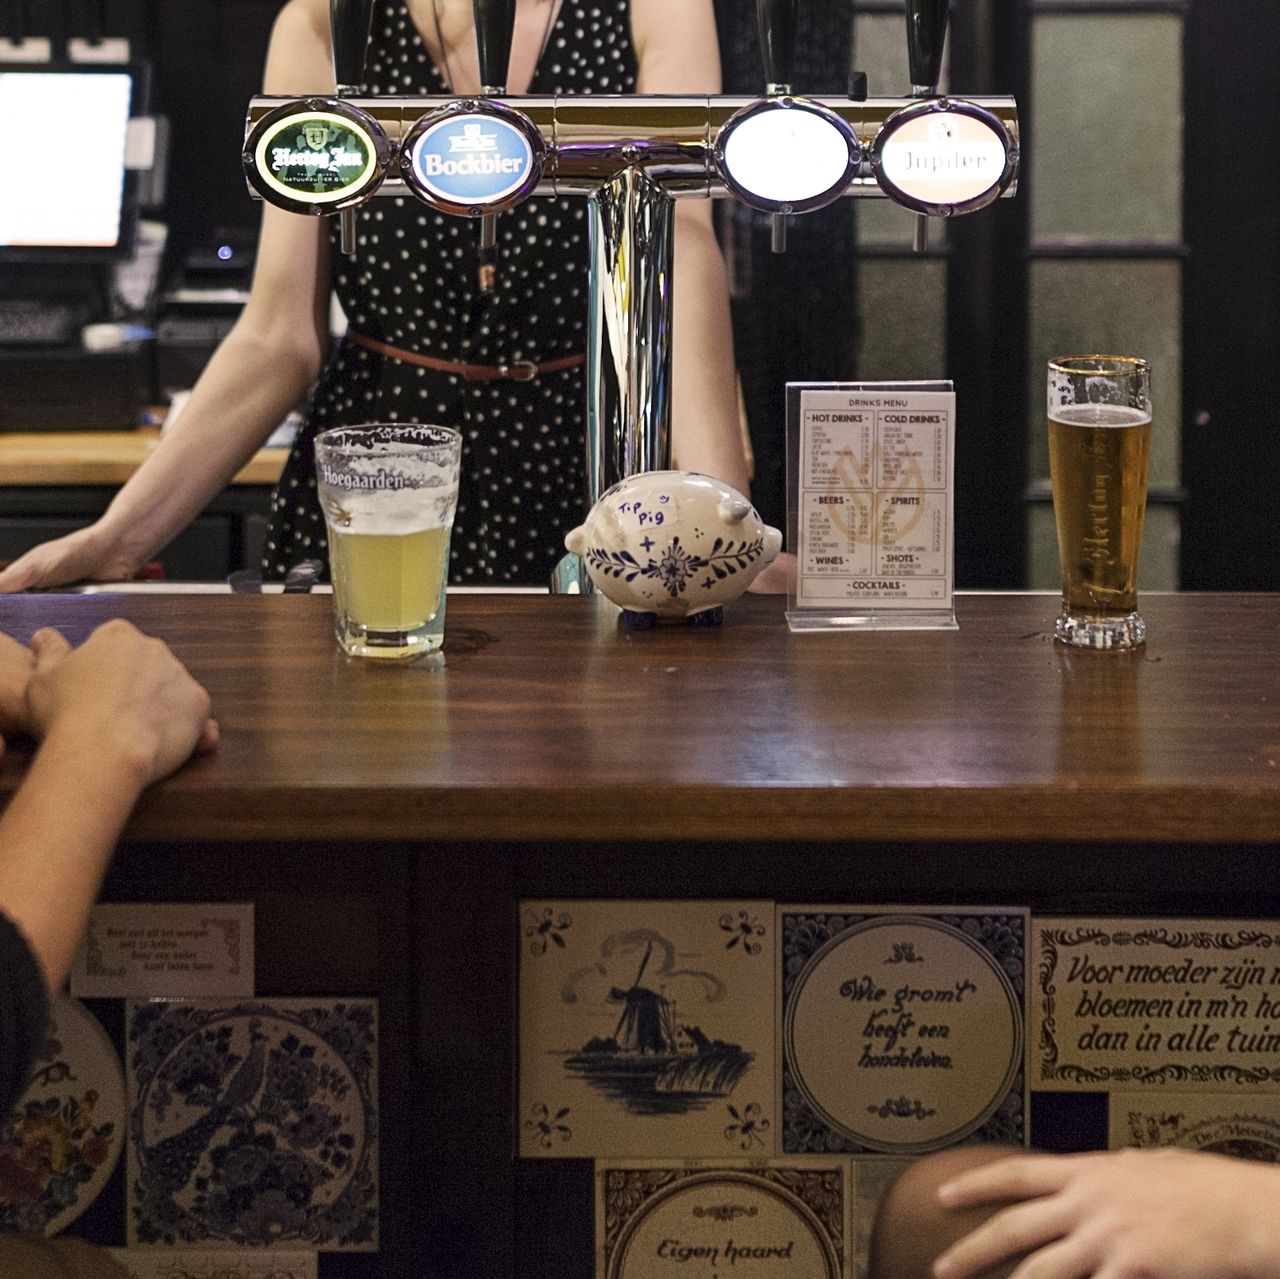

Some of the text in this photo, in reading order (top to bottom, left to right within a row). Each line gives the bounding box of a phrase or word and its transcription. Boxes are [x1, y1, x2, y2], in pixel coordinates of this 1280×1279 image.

[425, 153, 523, 176] Bockbier
[849, 399, 880, 407] DRINKS
[812, 414, 863, 423] HOT DRINKS
[884, 415, 940, 423] COLD DRINKS
[322, 464, 404, 490] Hoegaarden
[819, 496, 844, 504] BEERS
[890, 497, 920, 505] SPIRITS
[816, 556, 844, 564] WINES
[887, 554, 913, 562] SHOTS
[852, 581, 900, 589] COCKTAILS
[1066, 954, 1122, 984] Voor
[1125, 958, 1218, 985] moeder
[1220, 958, 1264, 990] zijn
[839, 975, 977, 1013] Wie gromt
[1074, 990, 1171, 1019] bloemen
[1176, 991, 1201, 1018] in
[1205, 993, 1248, 1019] m'n
[862, 1007, 951, 1053] heeft een
[1077, 1024, 1129, 1052] dan
[1135, 1023, 1162, 1052] in
[1167, 1024, 1220, 1053] alle
[657, 1238, 794, 1267] Eigen haard
